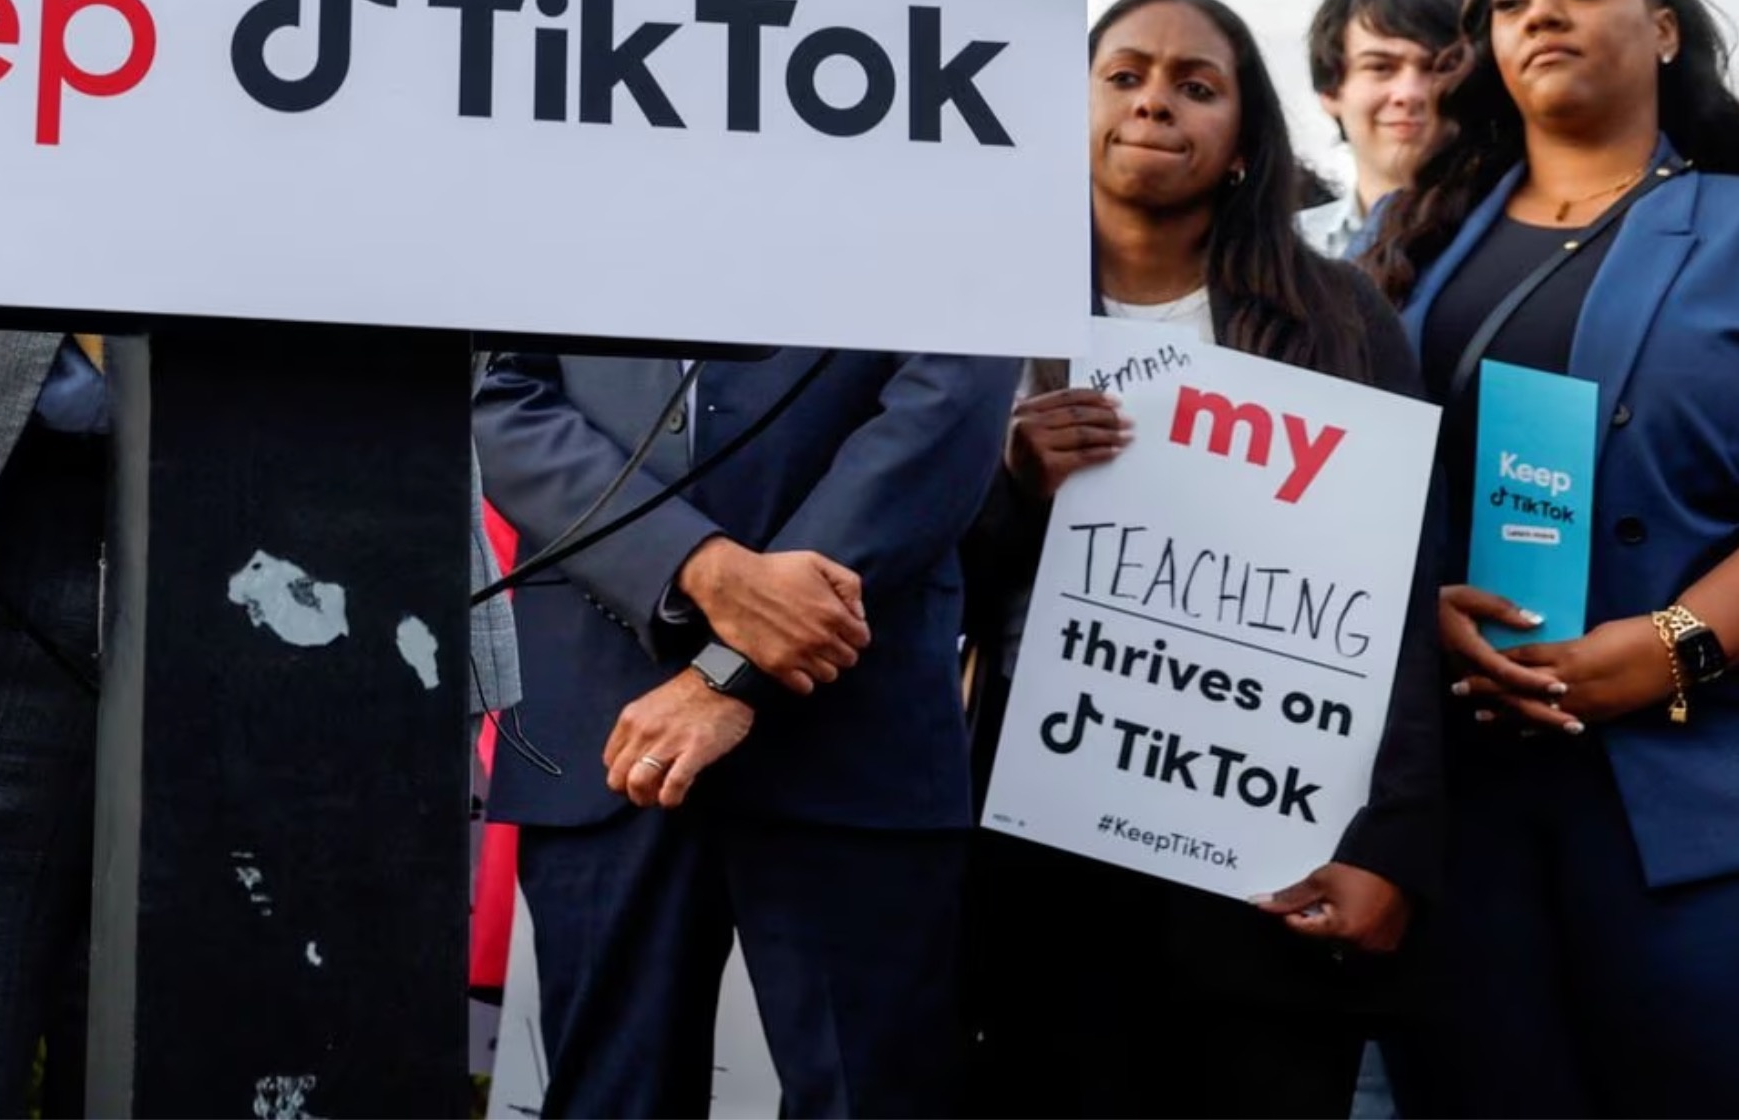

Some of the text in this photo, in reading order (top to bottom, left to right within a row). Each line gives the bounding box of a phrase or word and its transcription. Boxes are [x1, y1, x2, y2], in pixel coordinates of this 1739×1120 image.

[1169, 385, 1347, 504] my
[1499, 451, 1572, 497] Keep
[1510, 493, 1574, 524] TikTok
[1069, 522, 1372, 659] TEACHING
[1061, 619, 1353, 737] thrives on
[1113, 718, 1321, 824] TikTok
[1097, 813, 1239, 870] #KeepTikTok
